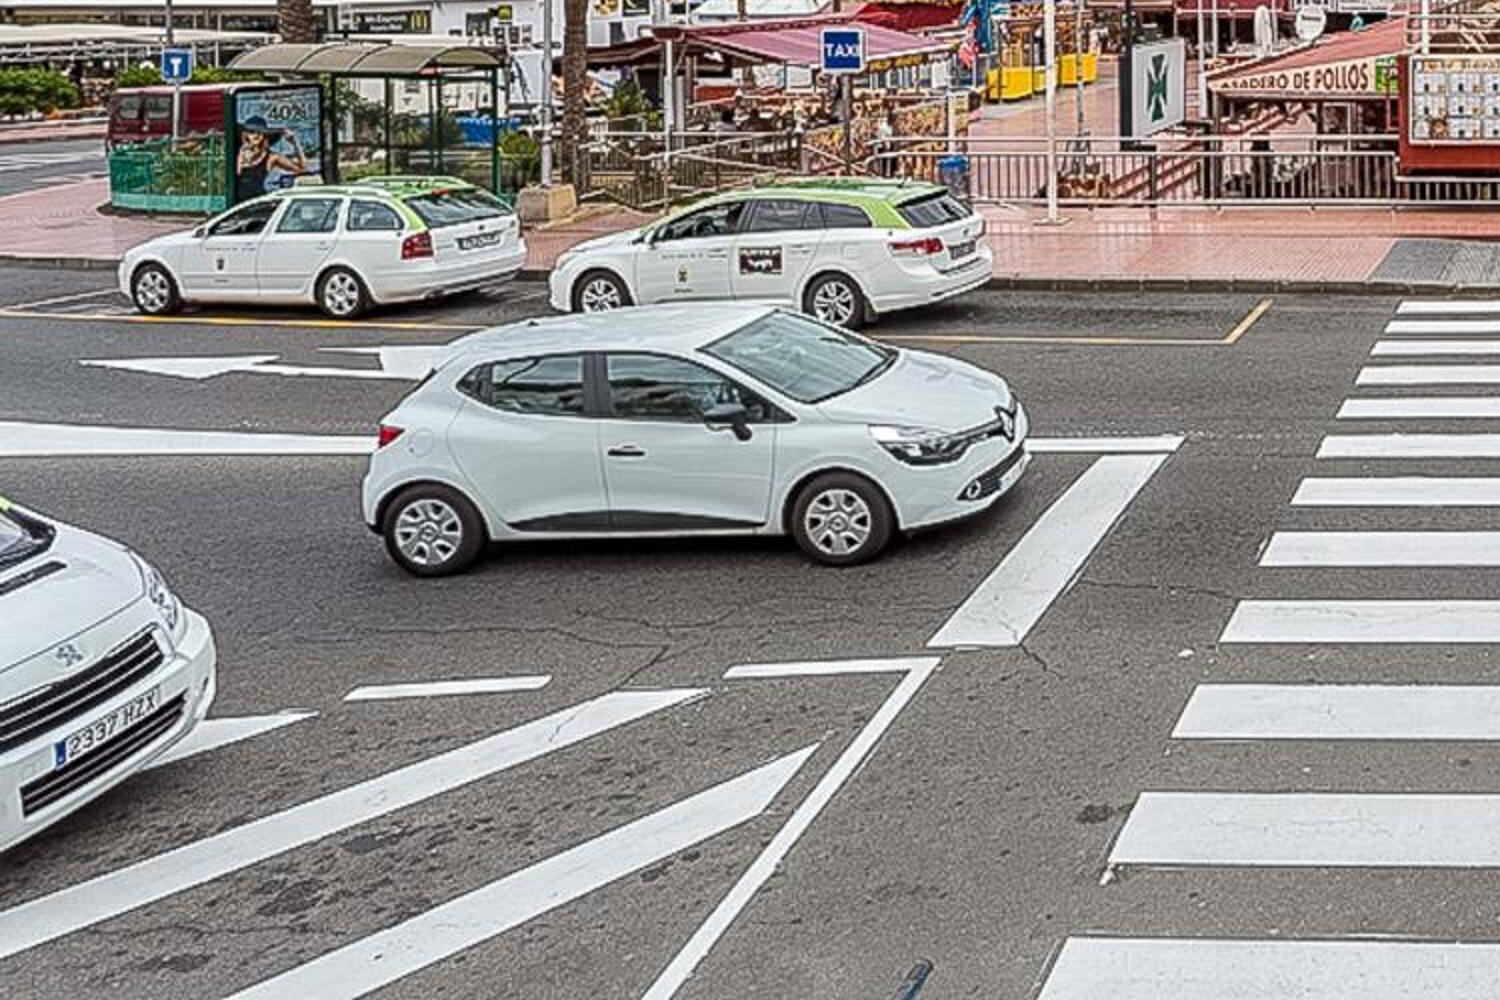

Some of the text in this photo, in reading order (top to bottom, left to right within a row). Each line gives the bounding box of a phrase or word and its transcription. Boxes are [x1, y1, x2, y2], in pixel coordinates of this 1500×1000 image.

[824, 43, 861, 57] TAXI
[1220, 63, 1370, 91] ASADERO DE POLLOS
[68, 690, 156, 758] 2337 HZX
